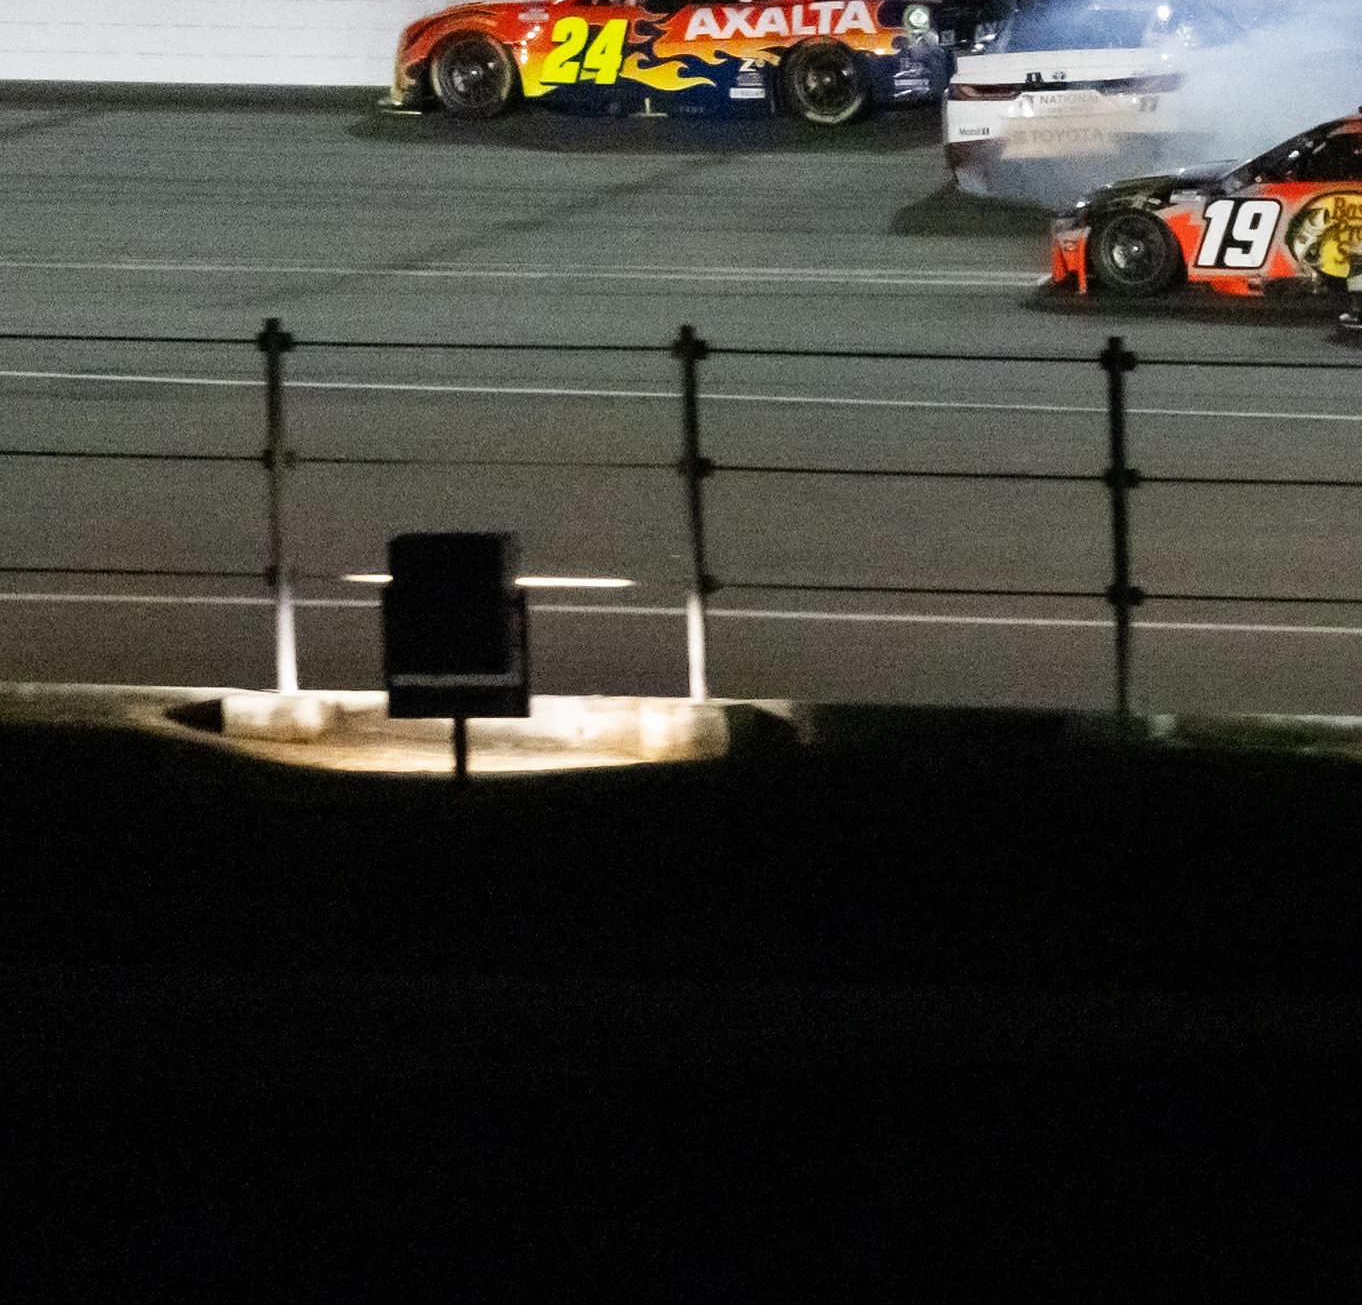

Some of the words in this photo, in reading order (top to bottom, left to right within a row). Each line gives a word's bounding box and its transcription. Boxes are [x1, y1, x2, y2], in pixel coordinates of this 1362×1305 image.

[684, 0, 876, 41] AXALTA
[540, 16, 628, 85] 24
[1031, 128, 1104, 144] TOYOTA
[1194, 198, 1283, 269] 19
